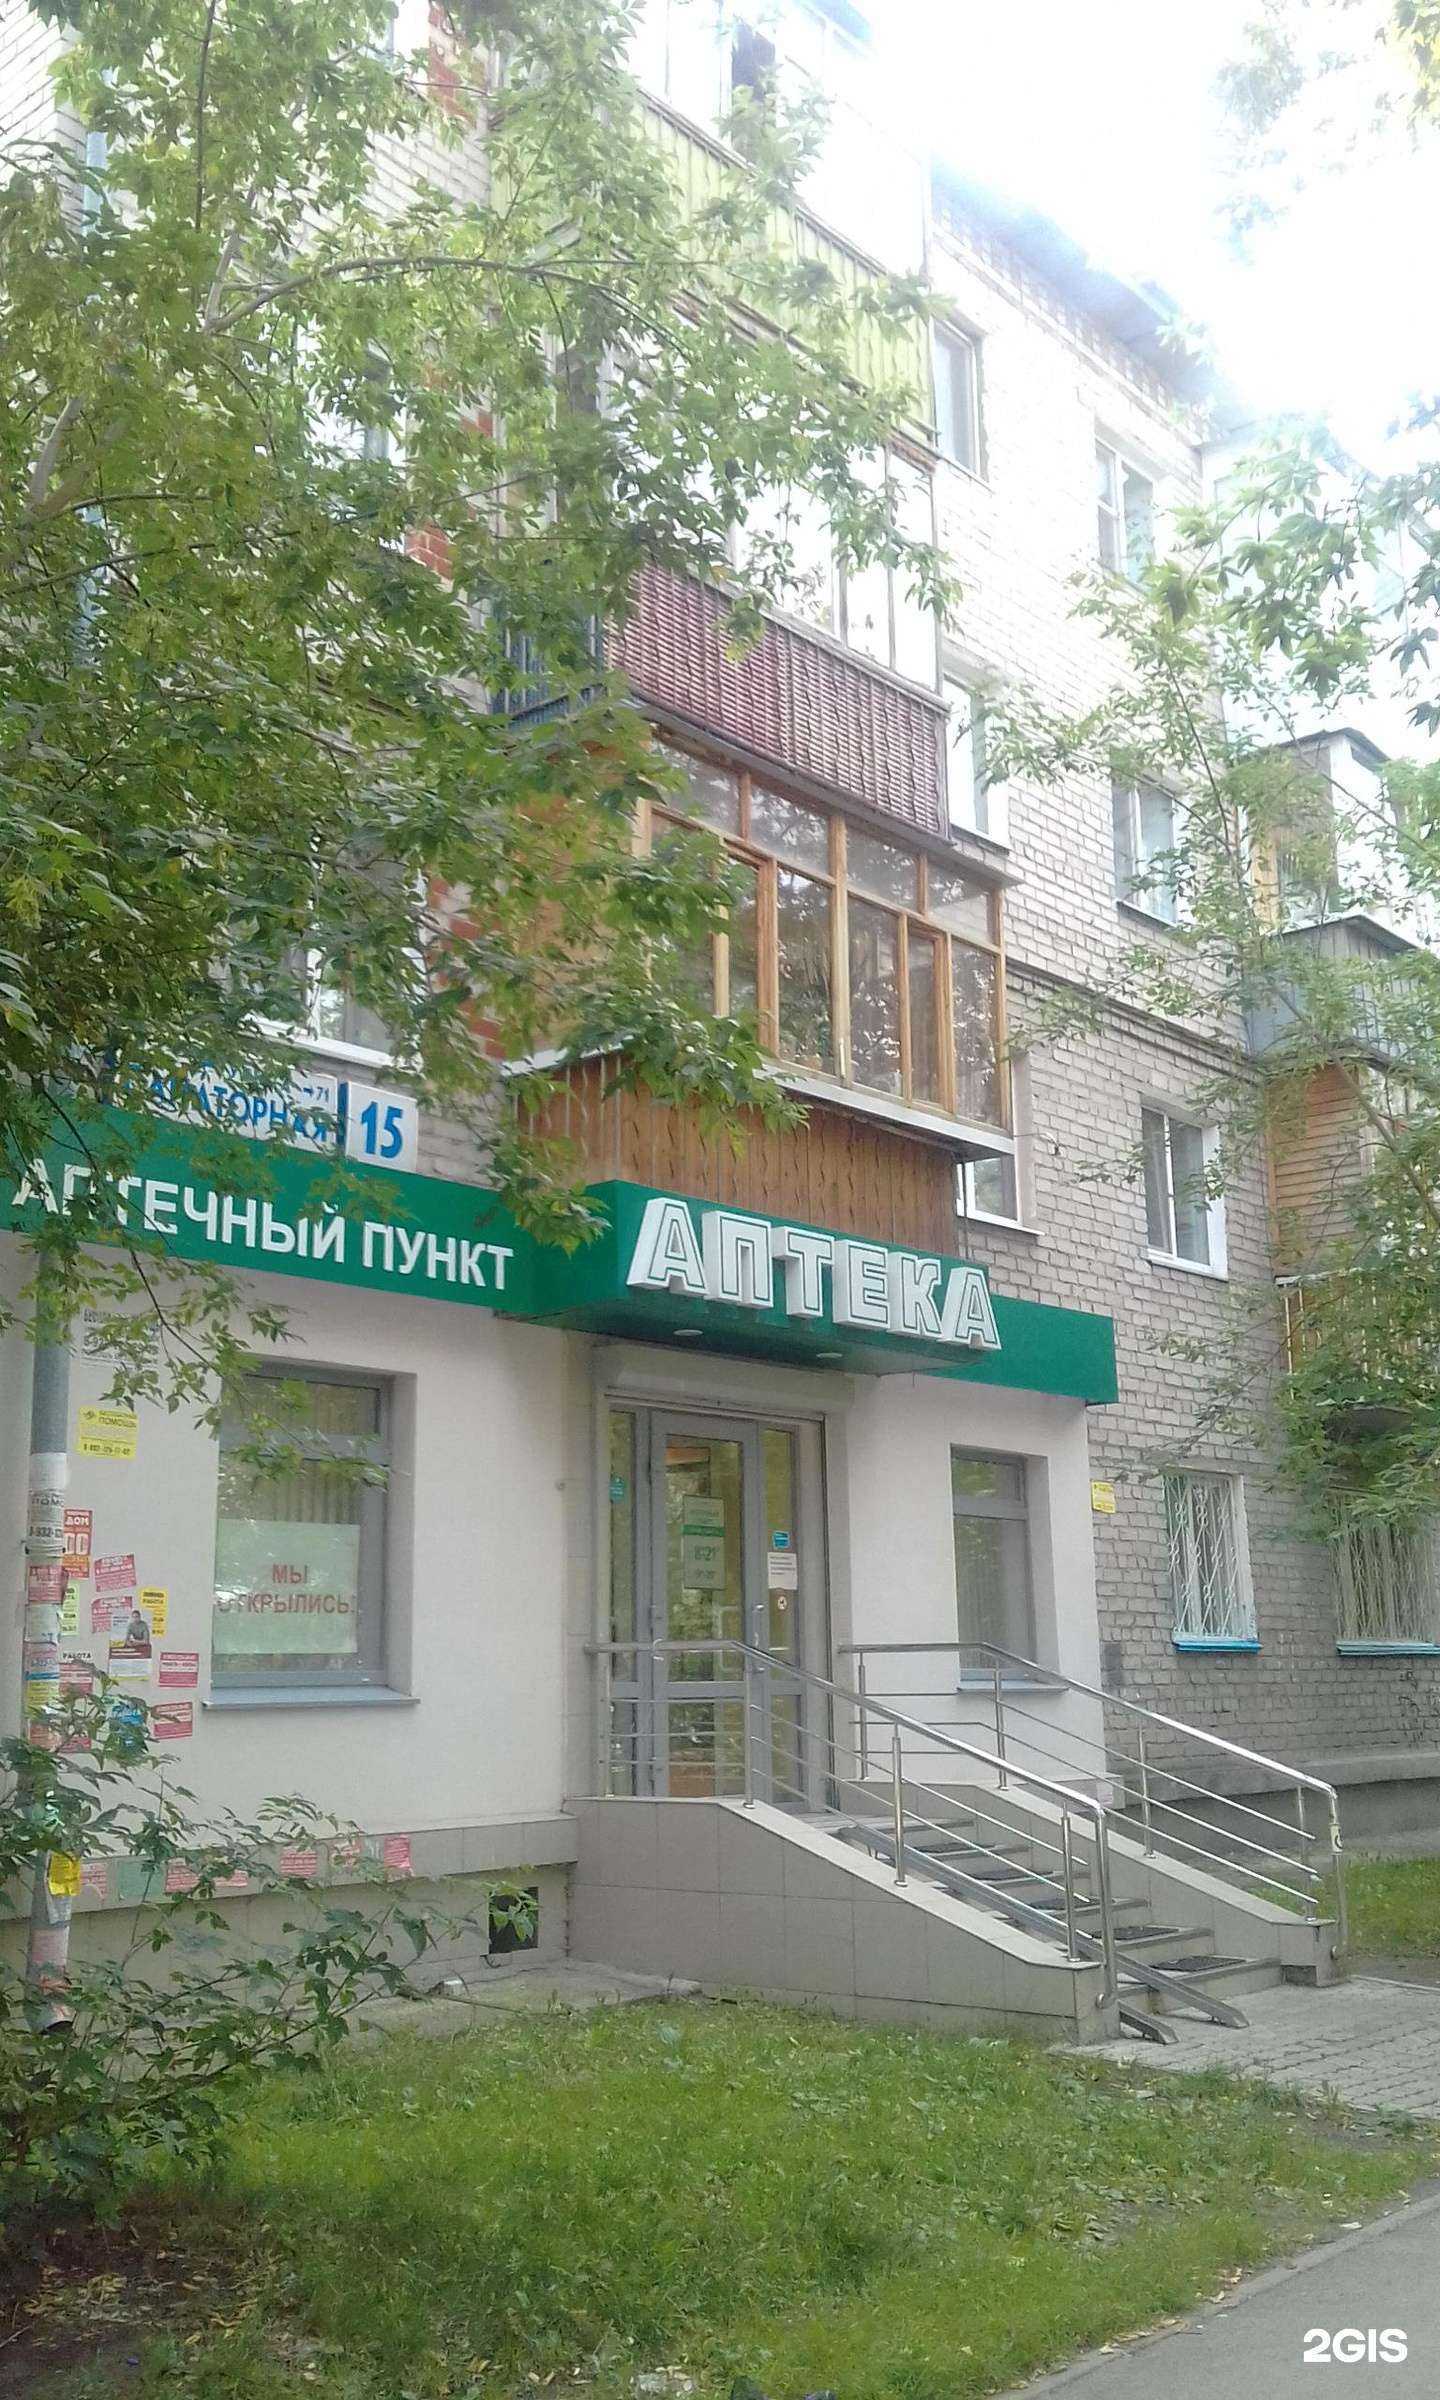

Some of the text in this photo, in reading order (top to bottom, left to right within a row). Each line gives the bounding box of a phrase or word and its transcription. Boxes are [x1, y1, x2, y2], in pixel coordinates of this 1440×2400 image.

[360, 1101, 404, 1159] 15
[11, 1157, 515, 1291] АПТЕЧНЫЙ ПУНКТ
[626, 1196, 1002, 1351] АПТЕКА
[272, 1564, 308, 1584] МЫ
